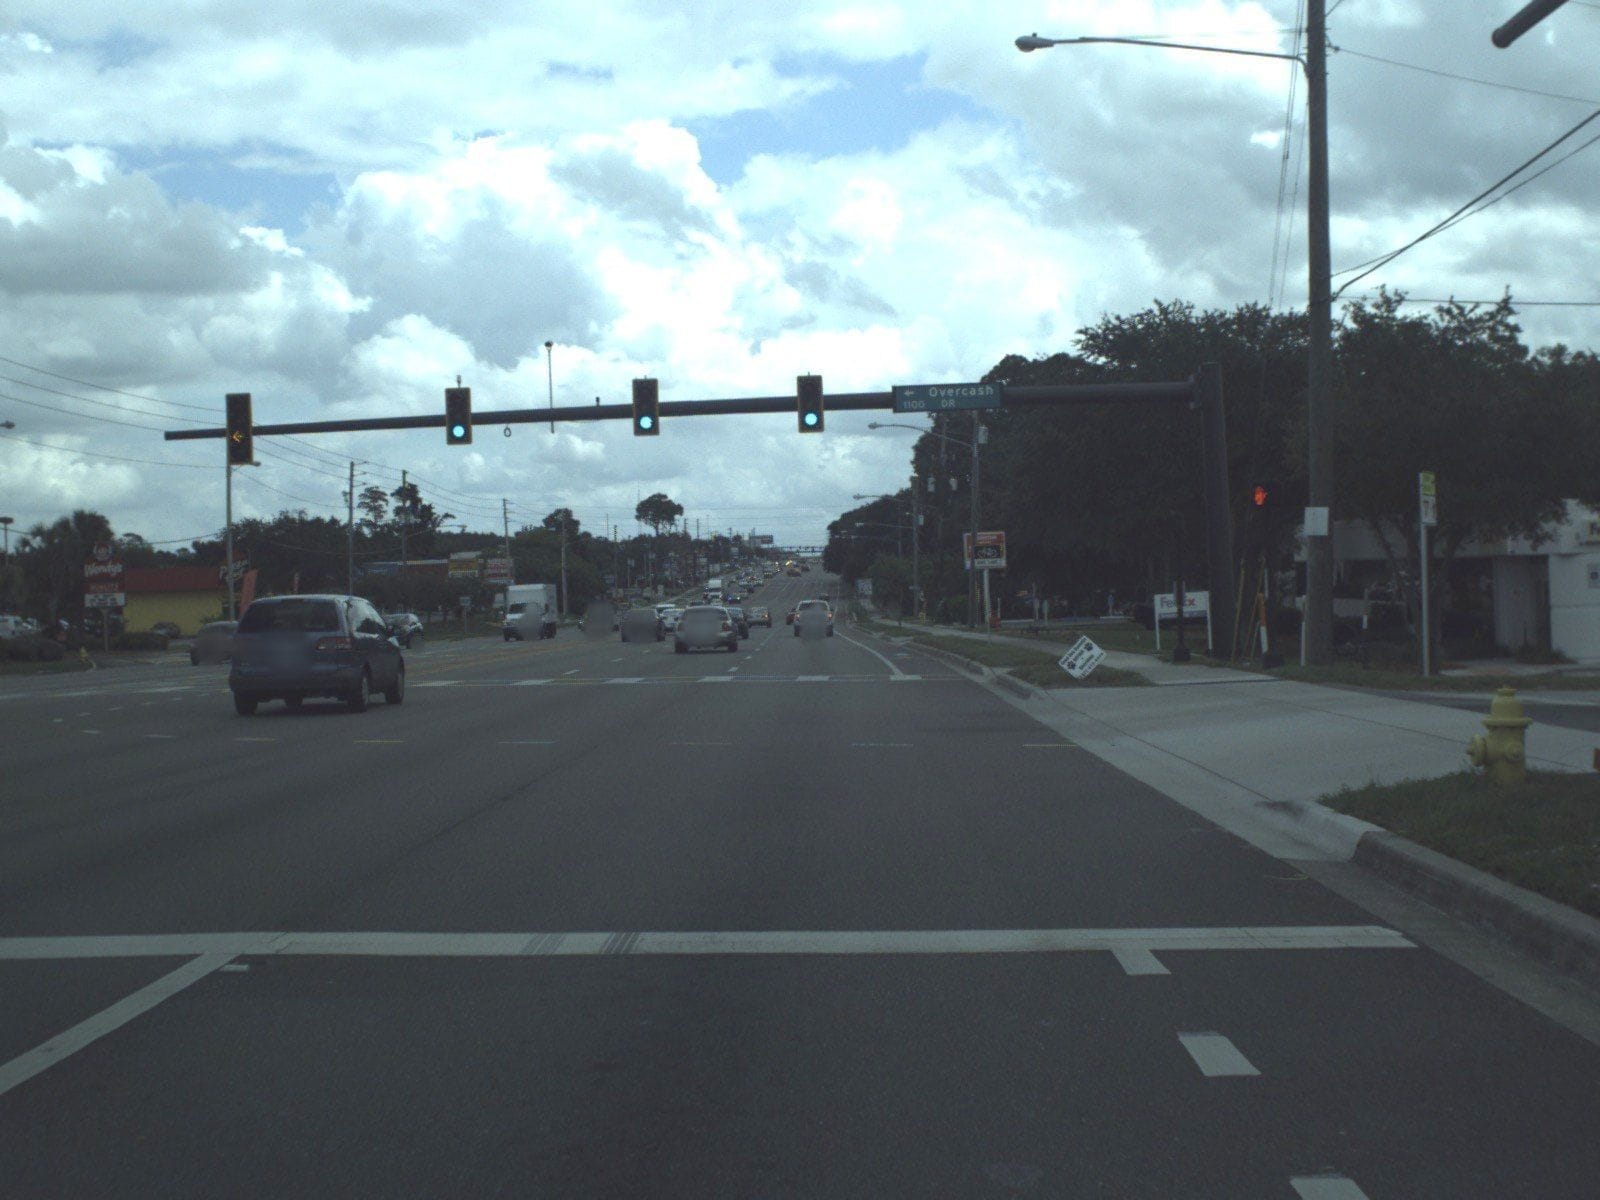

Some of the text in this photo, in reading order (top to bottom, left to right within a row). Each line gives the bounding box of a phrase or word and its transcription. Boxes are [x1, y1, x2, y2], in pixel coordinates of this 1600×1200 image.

[929, 386, 994, 397] Overcash
[903, 399, 956, 409] 1100 DR
[84, 560, 123, 577] Wendy's
